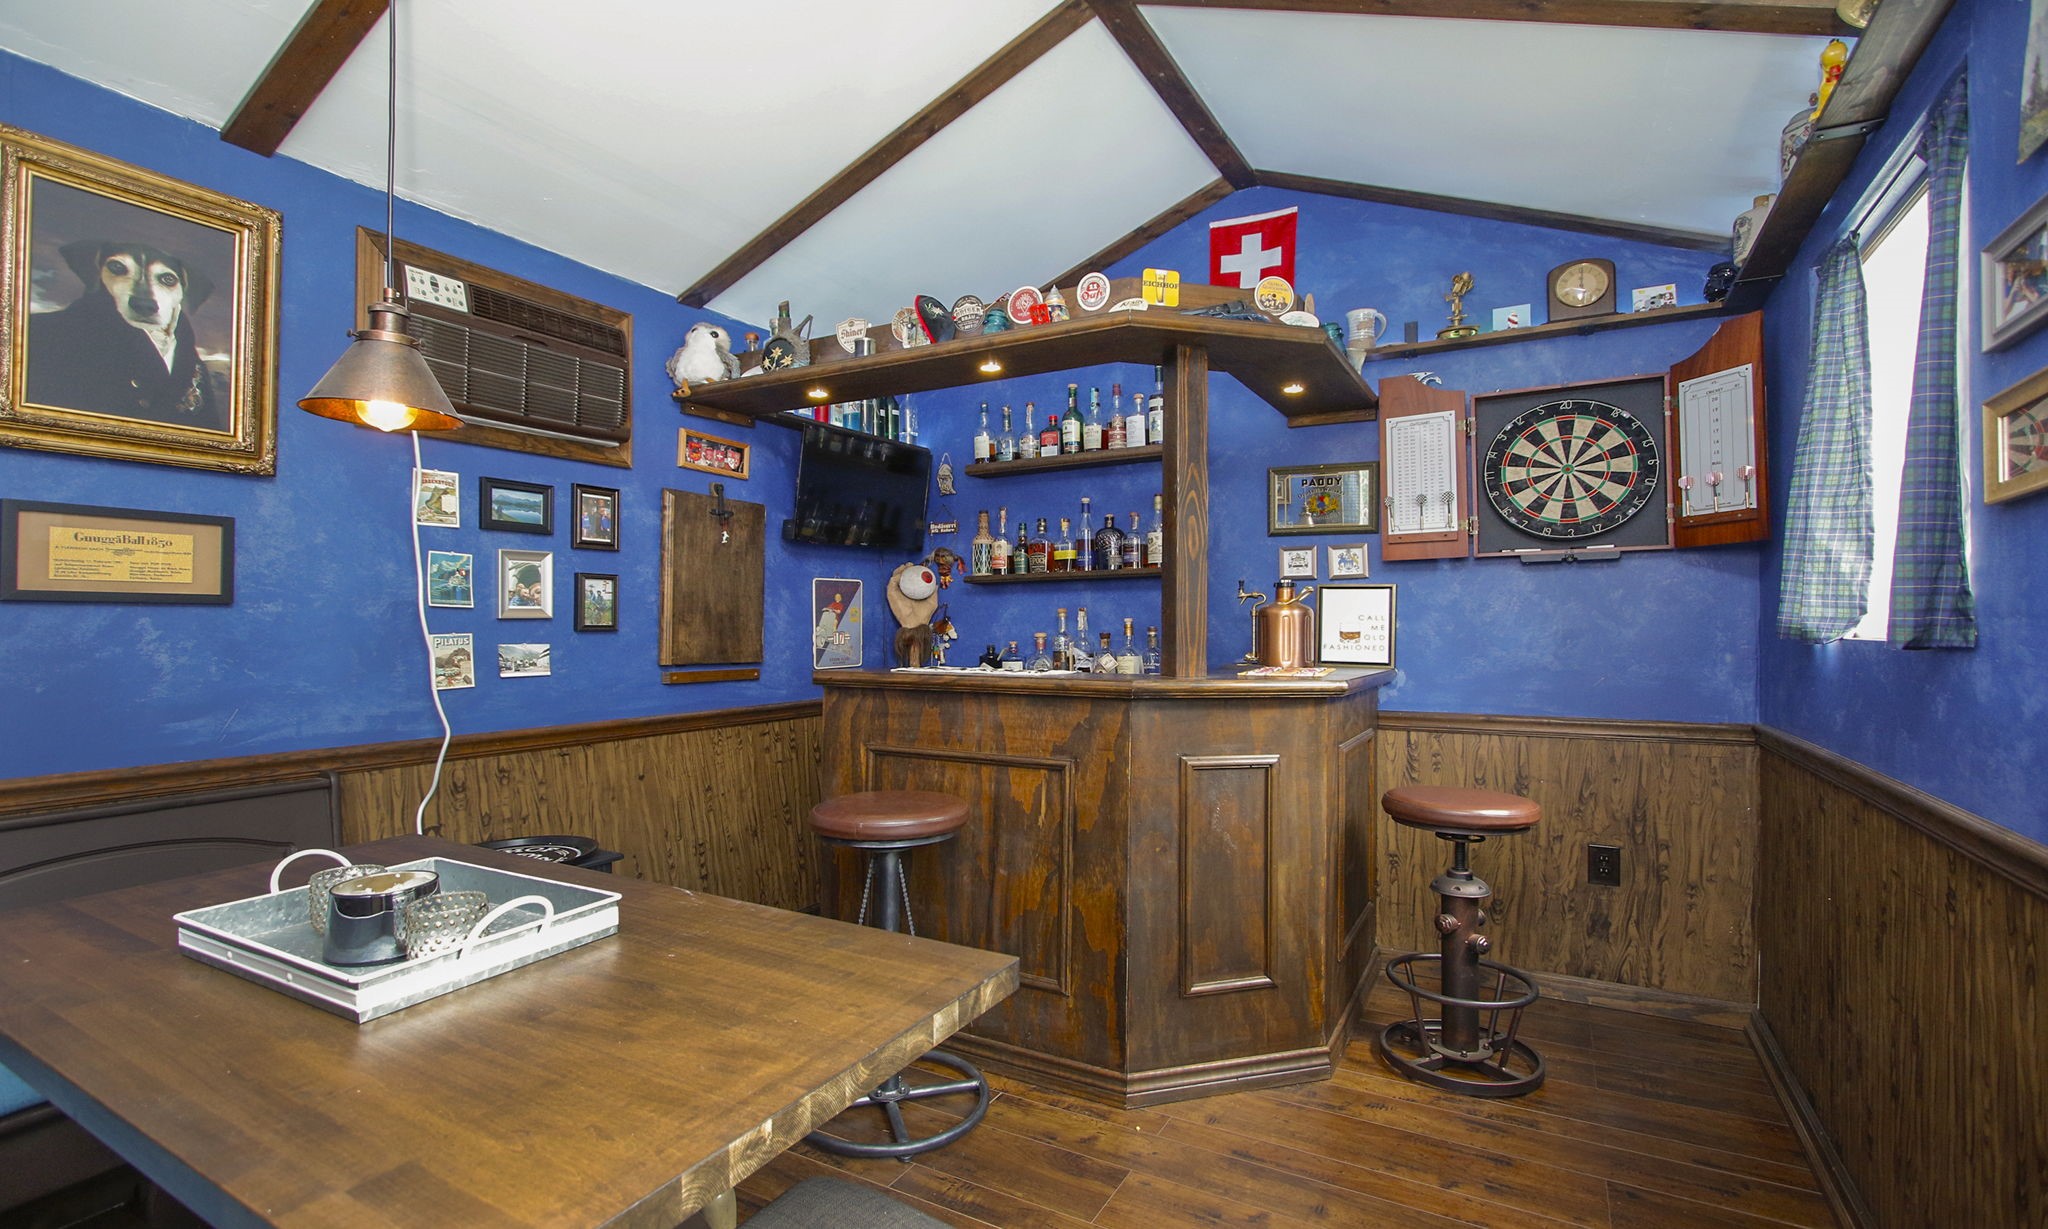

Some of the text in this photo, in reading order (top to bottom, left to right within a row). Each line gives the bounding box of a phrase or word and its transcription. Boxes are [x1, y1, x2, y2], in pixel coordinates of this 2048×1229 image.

[1559, 400, 1573, 410] 20
[1611, 407, 1622, 418] 18
[1484, 471, 1496, 480] 11
[1301, 477, 1342, 488] PADDY
[1520, 520, 1529, 529] 7
[1591, 523, 1602, 533] 17
[1542, 527, 1552, 537] 19
[1567, 528, 1575, 538] 3
[434, 638, 470, 648] PILATUS
